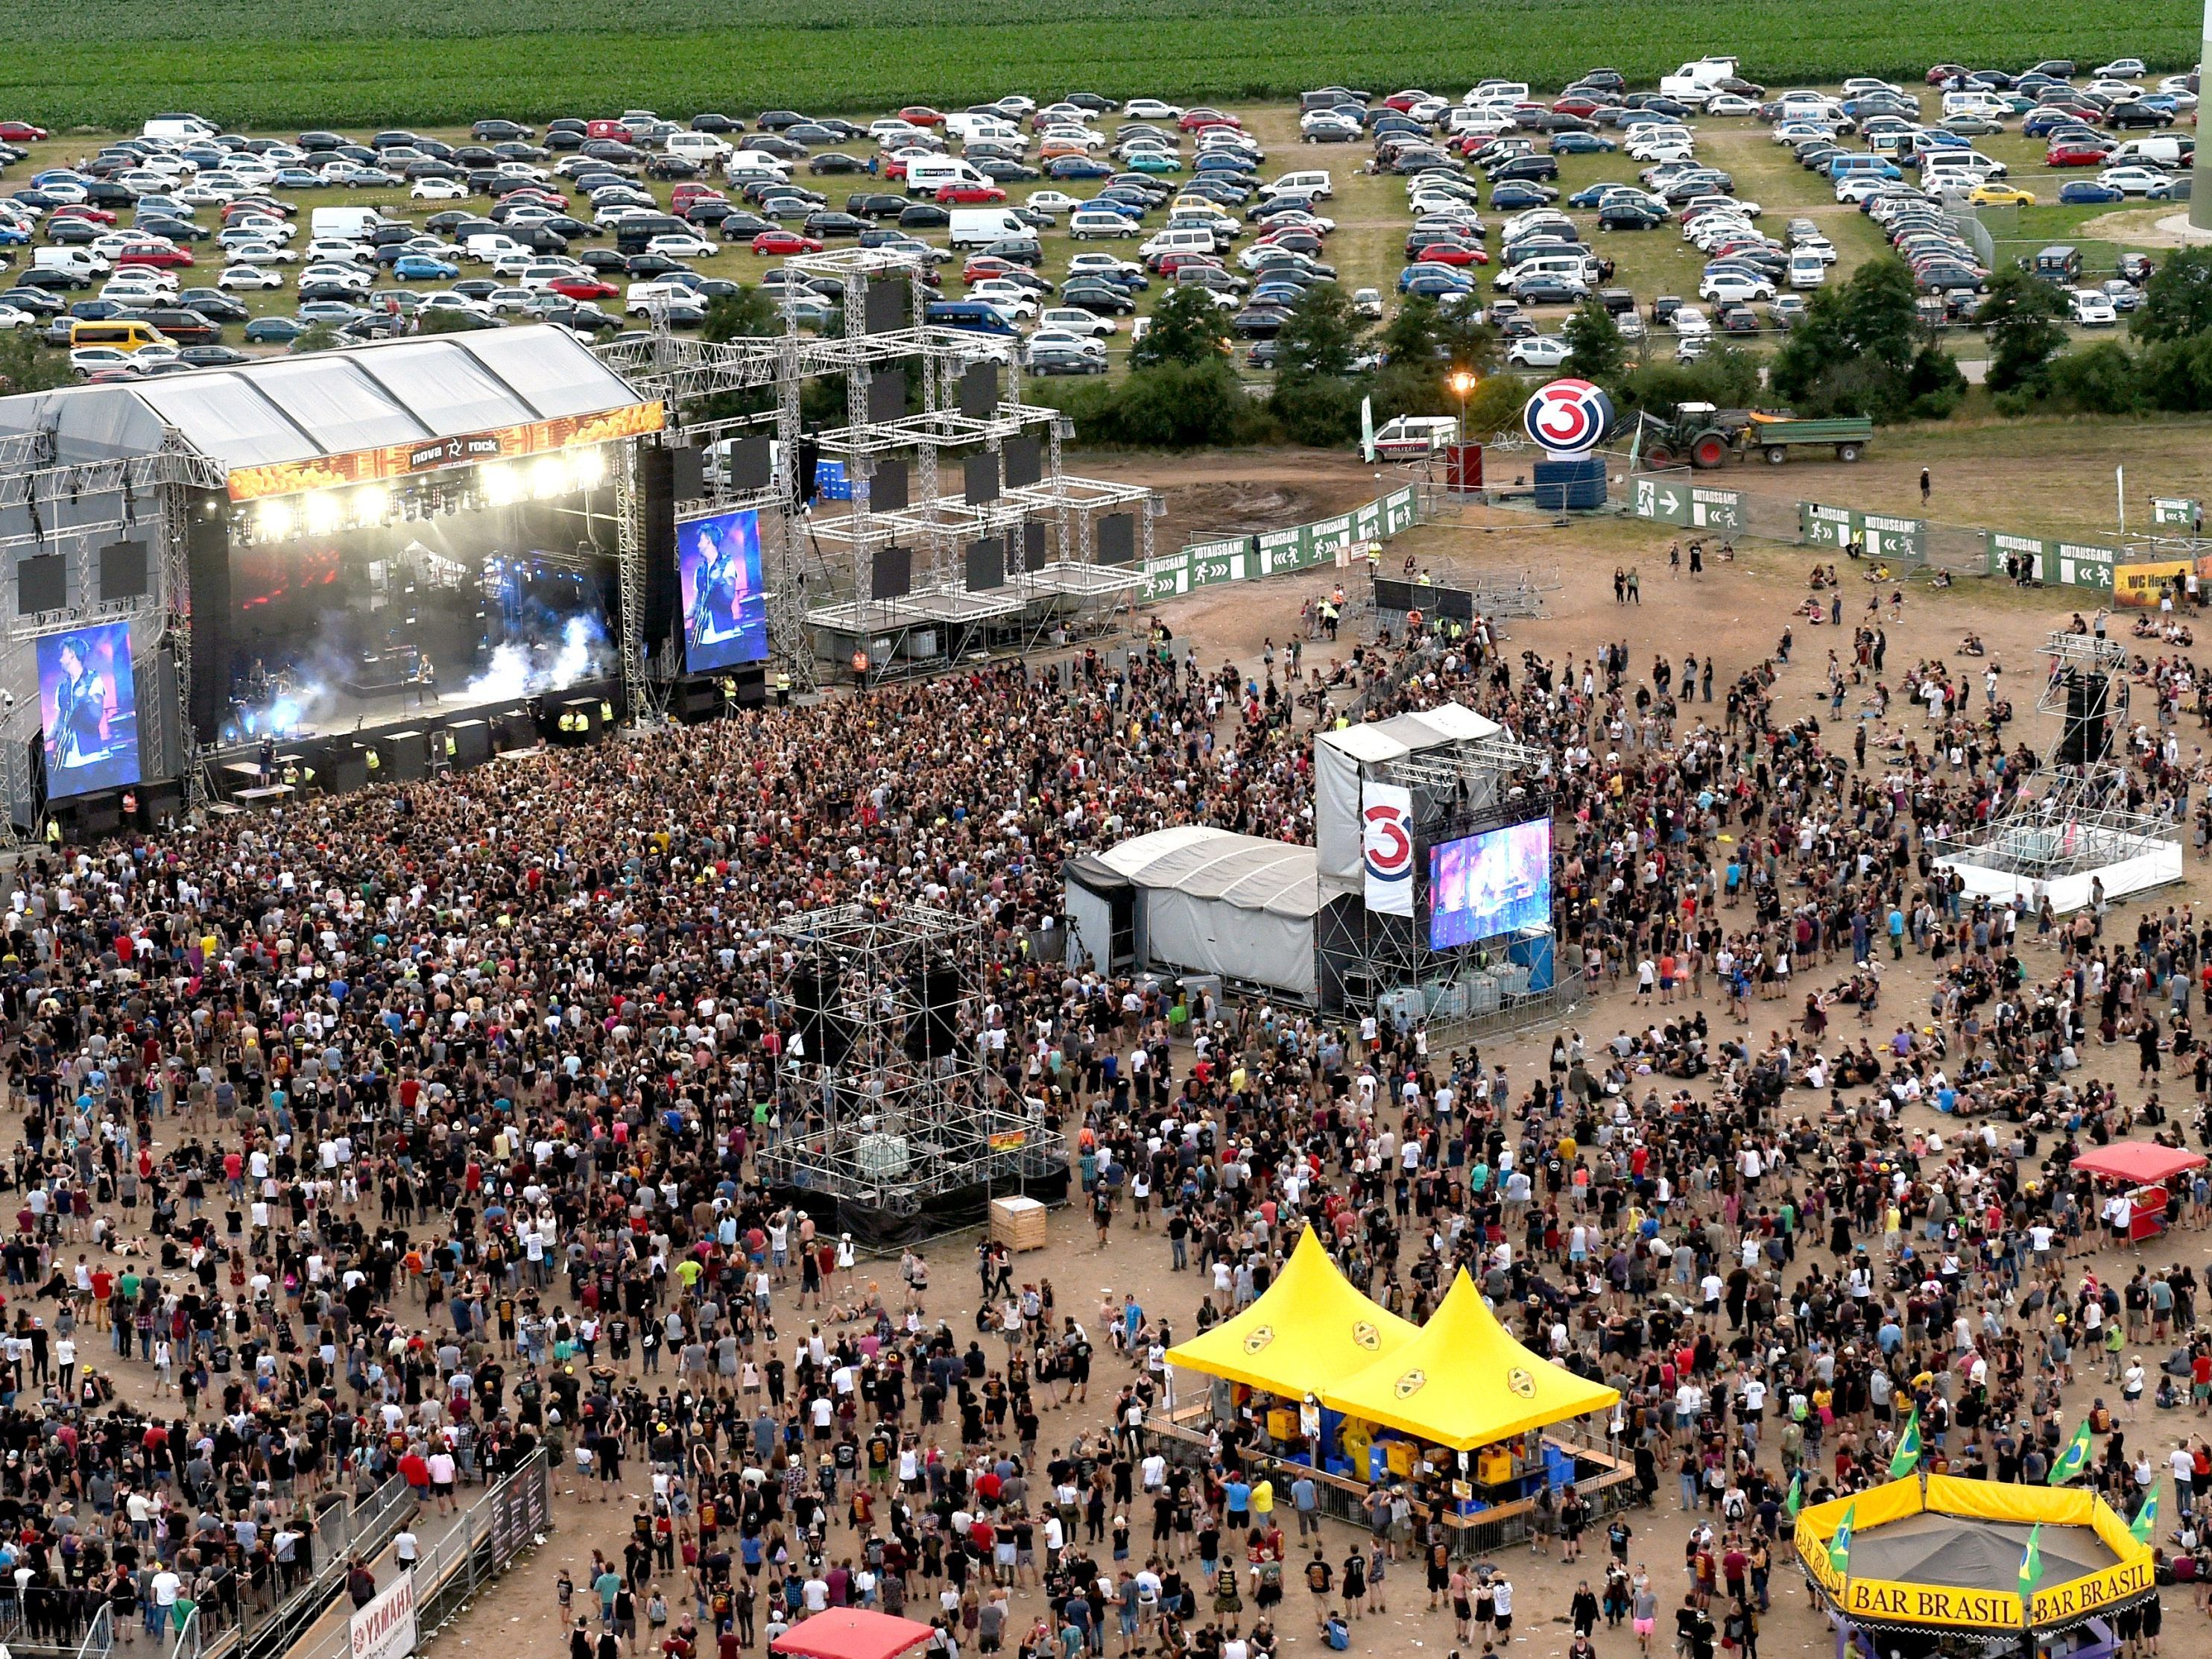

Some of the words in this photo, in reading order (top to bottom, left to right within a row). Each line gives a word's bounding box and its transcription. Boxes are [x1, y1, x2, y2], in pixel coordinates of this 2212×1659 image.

[412, 446, 443, 465] nova
[468, 440, 497, 452] rock
[1693, 489, 1737, 505] NOTAUSGANG
[1865, 516, 1915, 534] NOTAUSGANG
[1260, 530, 1299, 549] NOTAUSGANG
[1995, 534, 2042, 553] NOTAUSGANG
[2060, 544, 2113, 563] NOTAUSGANG
[2128, 575, 2146, 589] WC
[2036, 1590, 2076, 1622] BAR
[2080, 1564, 2152, 1608] BRASIL
[365, 1584, 412, 1645] YAMAHA
[1854, 1585, 1910, 1614] BAR
[1917, 1592, 2018, 1625] BRASIL
